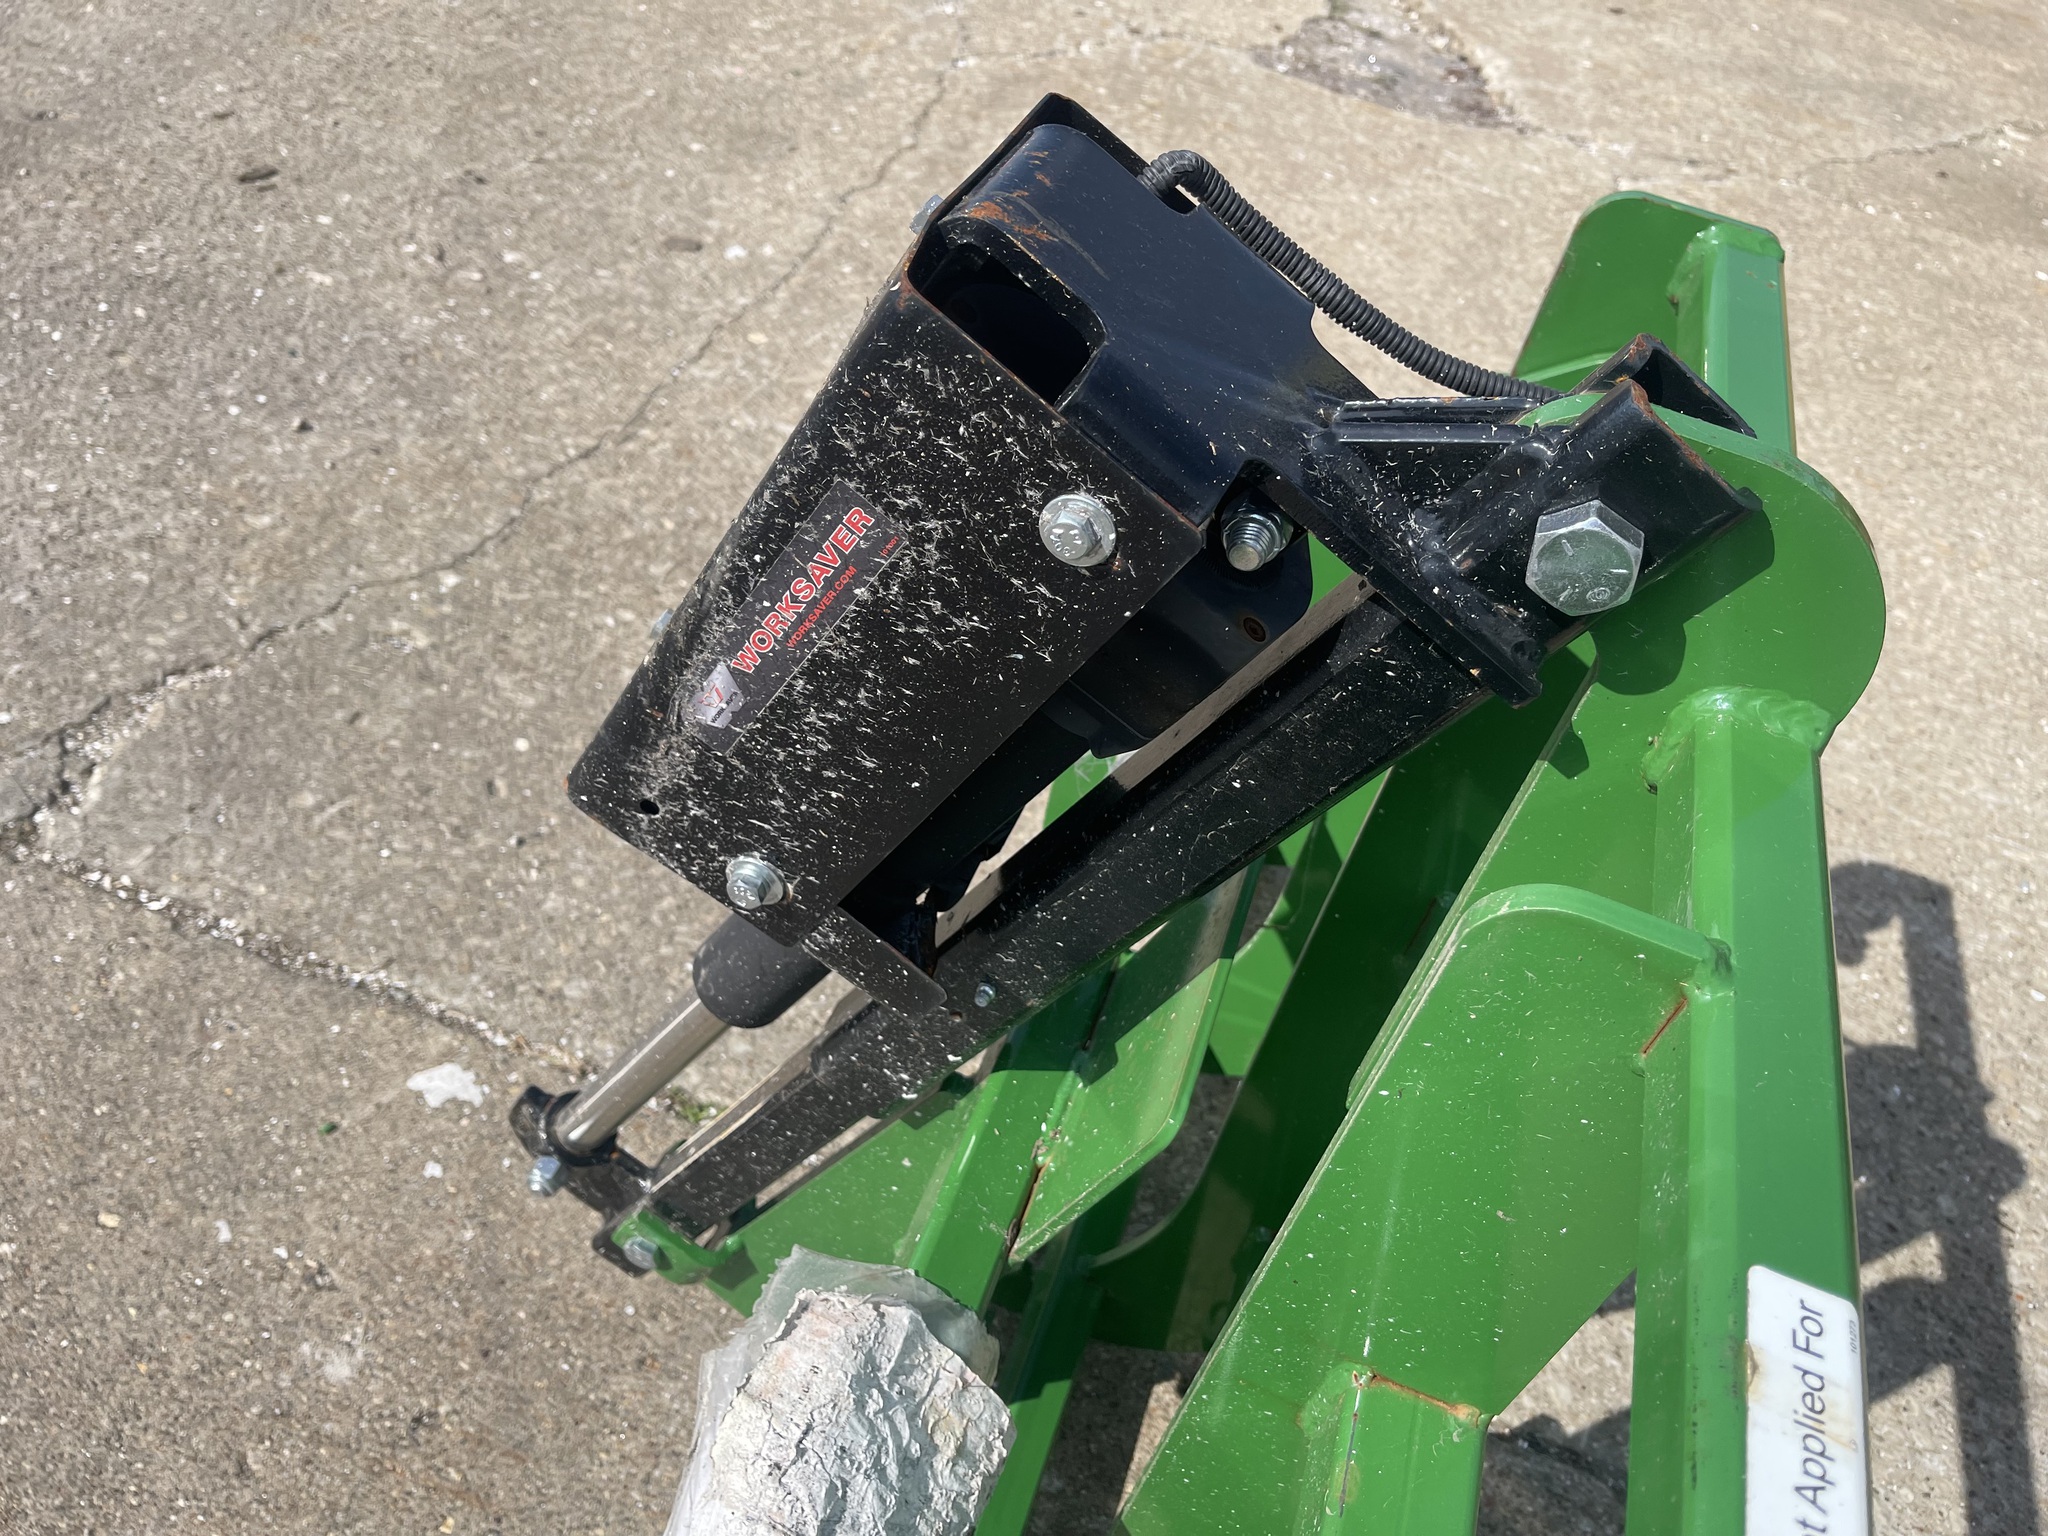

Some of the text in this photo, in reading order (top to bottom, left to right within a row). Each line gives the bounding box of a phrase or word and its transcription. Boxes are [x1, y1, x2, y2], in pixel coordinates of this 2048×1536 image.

[732, 507, 875, 673] WORKSAVER
[786, 565, 858, 648] WORKSAVER.COM
[1792, 1298, 1836, 1536] t Applied For
